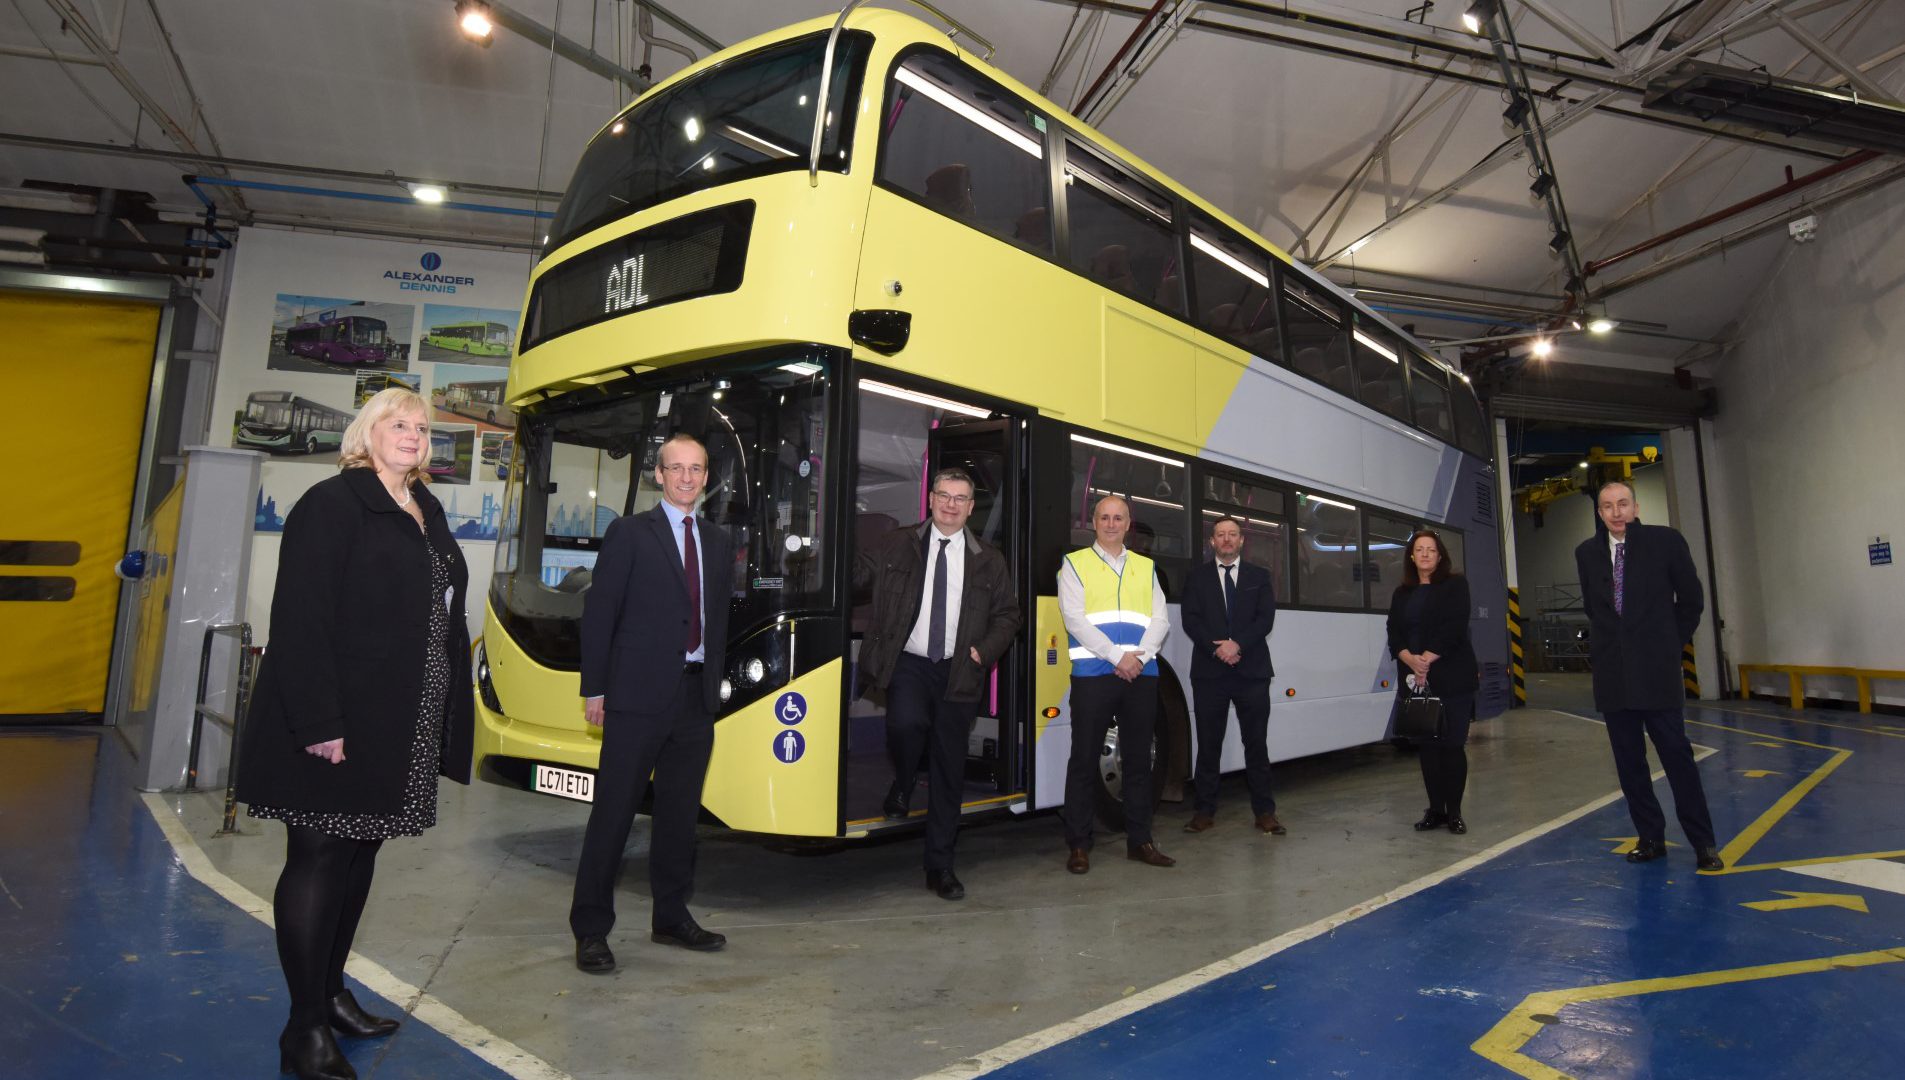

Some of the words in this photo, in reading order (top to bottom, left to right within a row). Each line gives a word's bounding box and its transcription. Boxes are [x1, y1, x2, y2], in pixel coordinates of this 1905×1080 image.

[383, 270, 475, 286] ALEXANDER
[400, 281, 457, 294] DENNIS
[604, 254, 649, 313] ADL
[539, 768, 565, 792] LC71
[566, 773, 590, 796] ETD
